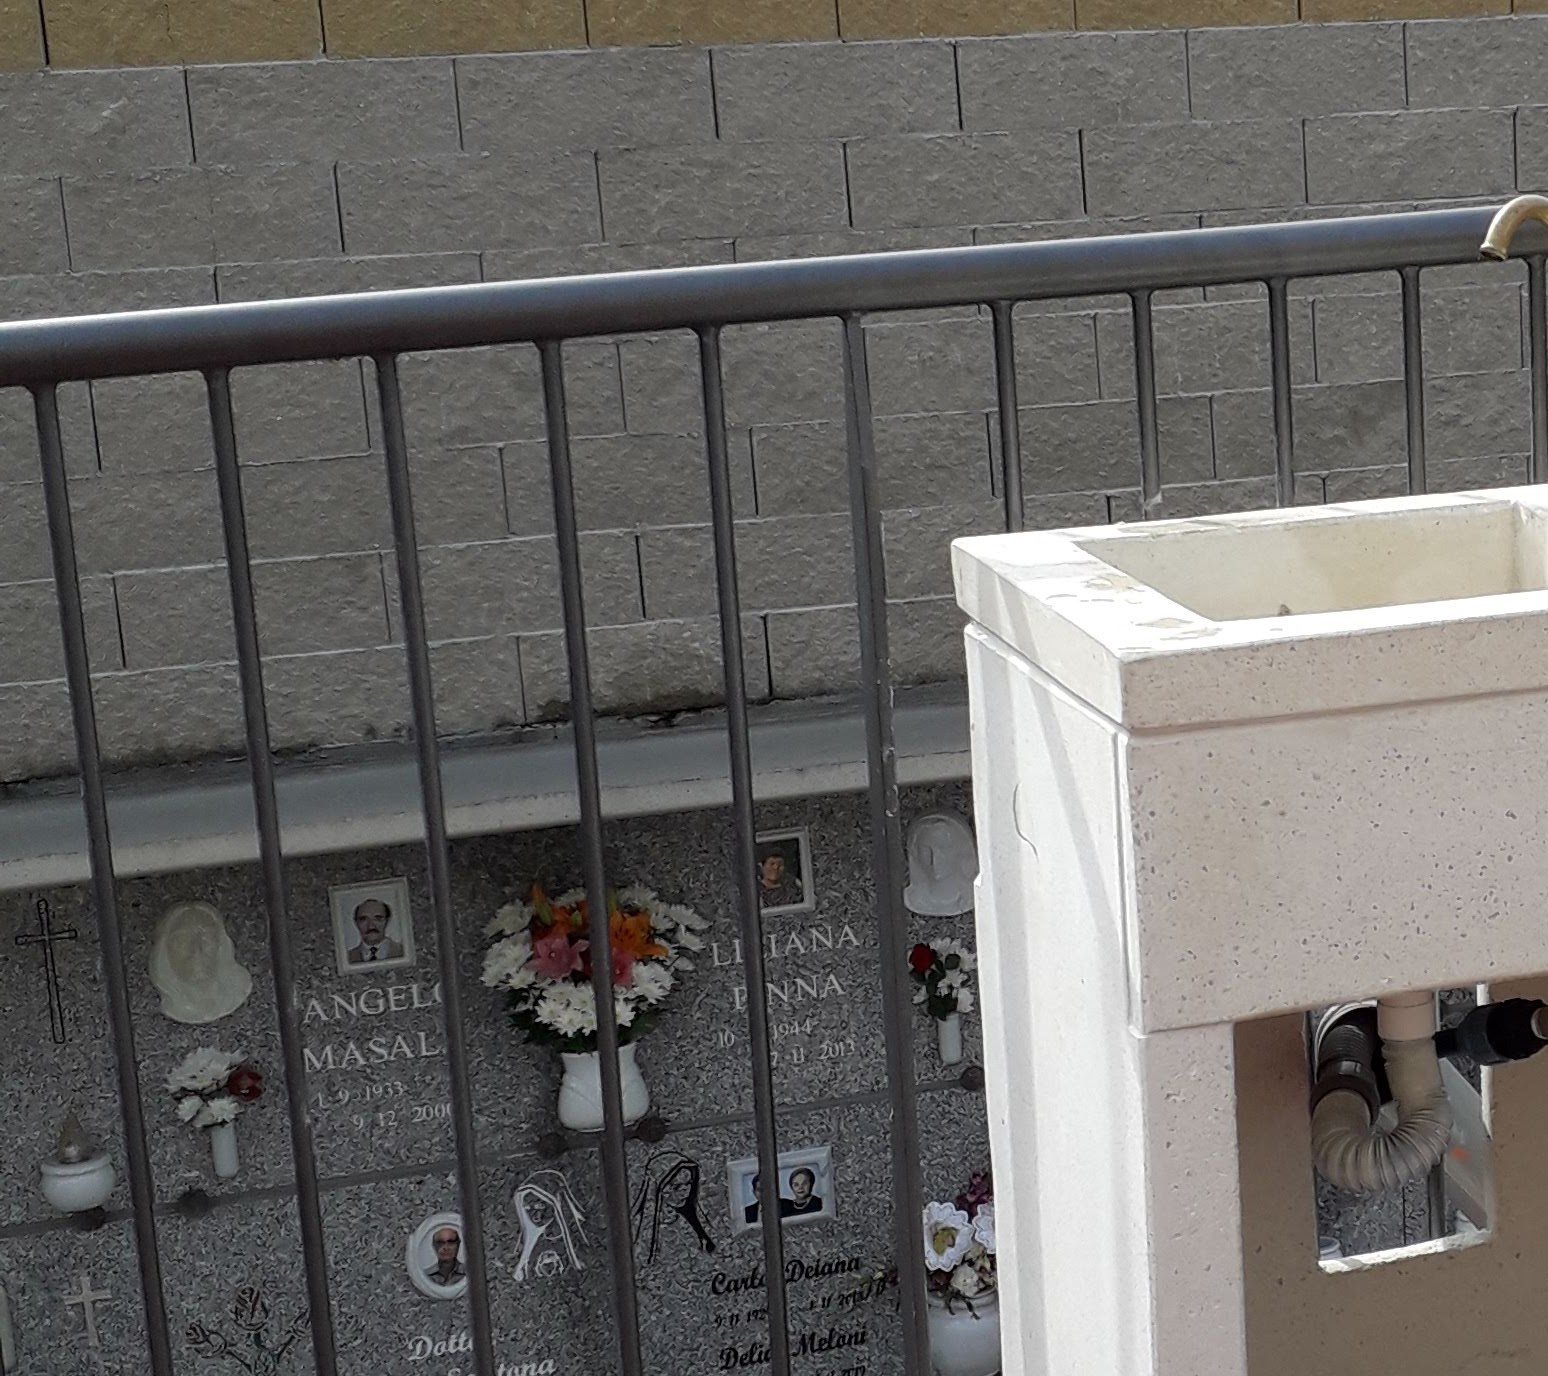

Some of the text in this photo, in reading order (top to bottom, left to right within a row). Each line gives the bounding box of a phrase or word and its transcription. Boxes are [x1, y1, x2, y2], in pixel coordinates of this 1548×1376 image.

[711, 925, 860, 966] LIIANA
[303, 982, 443, 1023] ANGEL
[733, 974, 846, 1010] PNNA
[302, 1031, 446, 1073] MASAL
[407, 1331, 473, 1361] Dott
